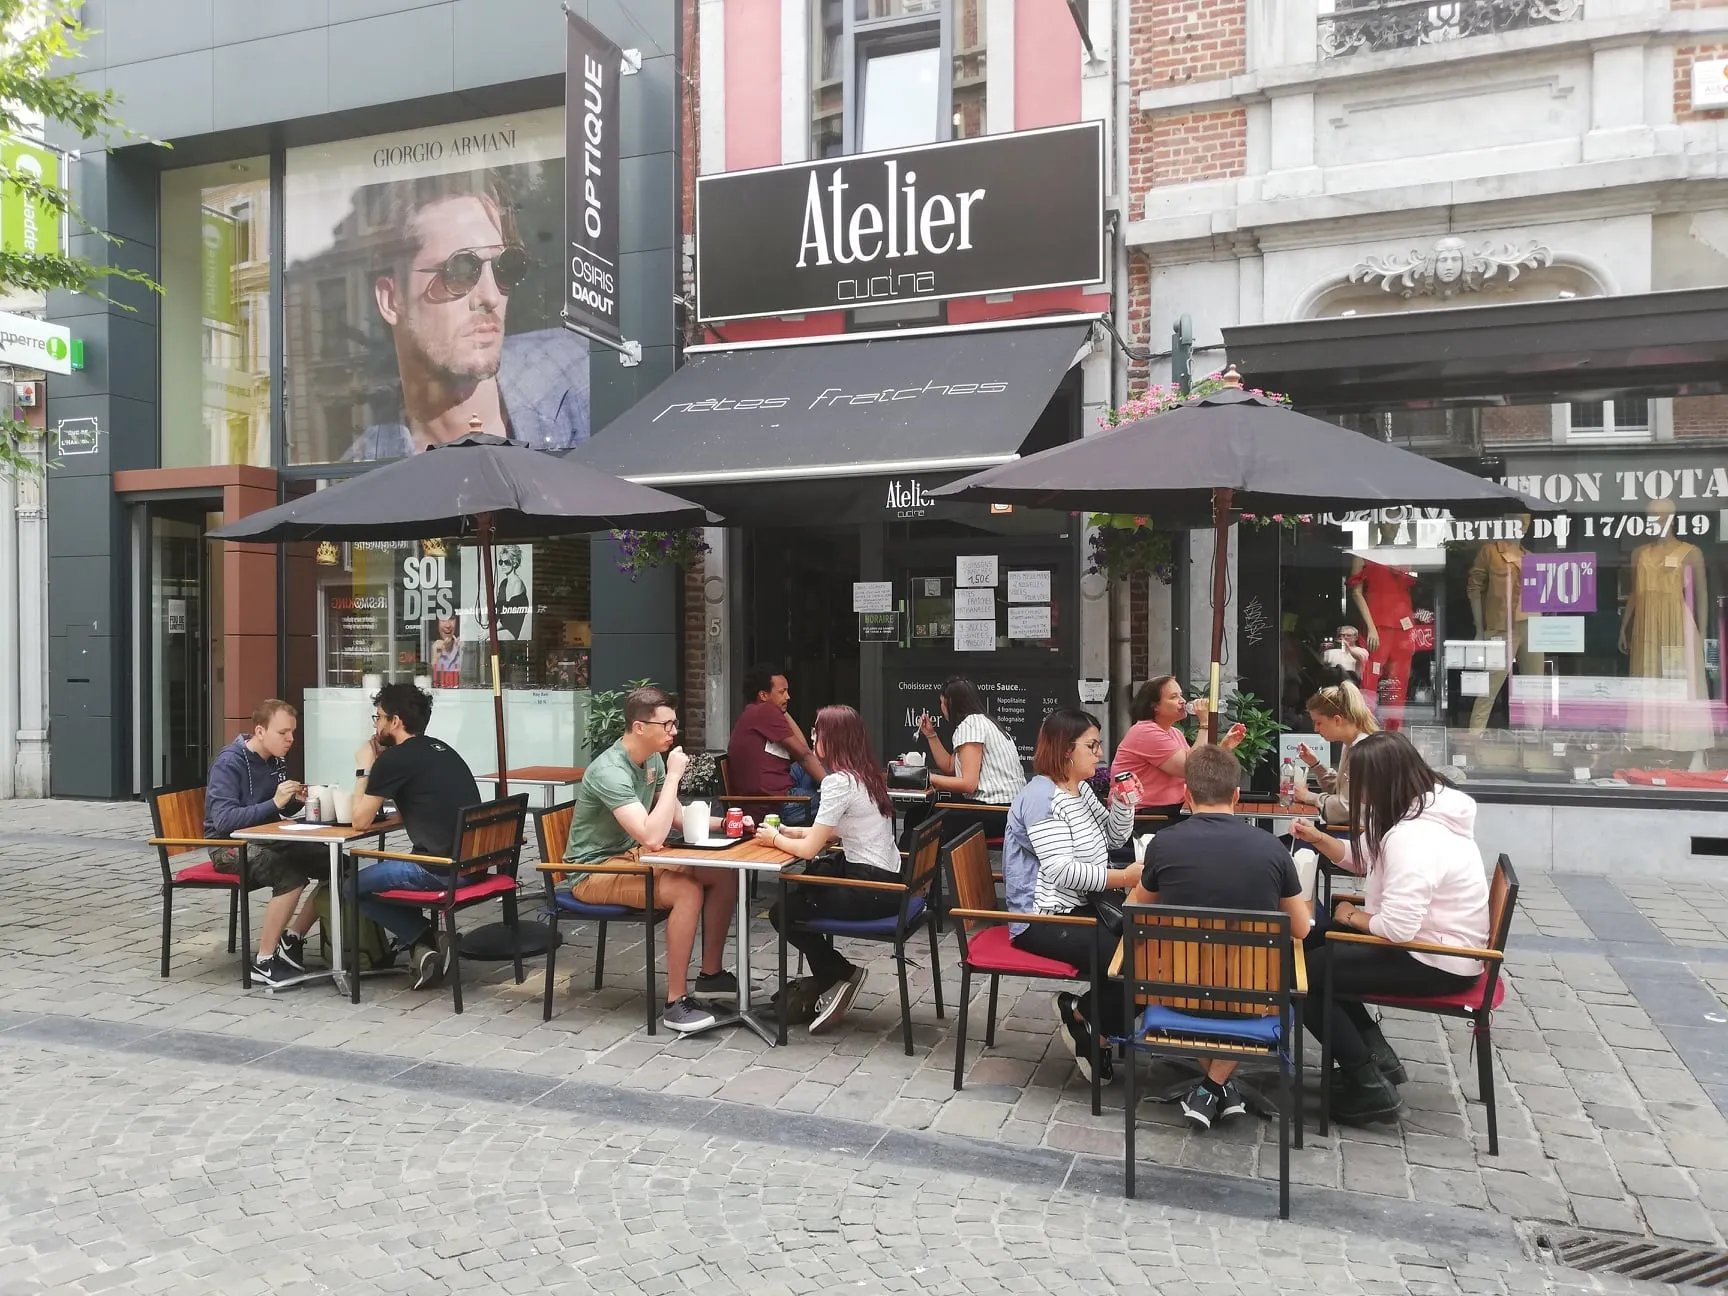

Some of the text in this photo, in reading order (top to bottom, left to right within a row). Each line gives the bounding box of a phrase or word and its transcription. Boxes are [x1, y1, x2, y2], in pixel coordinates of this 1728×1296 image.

[373, 129, 516, 168] GIORGIO ARMANI
[584, 53, 603, 240] OPTIQUE
[796, 159, 986, 268] Atelier
[572, 255, 614, 294] OSIRIS
[837, 267, 935, 301] cucina
[572, 281, 615, 315] DAOUT
[1615, 467, 1728, 501] TOTA
[1533, 516, 1572, 539] DU
[1584, 514, 1711, 539] 17/05/19
[403, 556, 453, 589] SOL
[1524, 562, 1593, 604] -70%
[403, 588, 453, 621] DES
[709, 618, 721, 637] 5
[898, 681, 932, 690] Choisissez
[977, 683, 995, 691] votre
[997, 697, 1026, 705] Napolitaine
[997, 715, 1025, 724] Bolognaise
[1001, 706, 1025, 714] fromages
